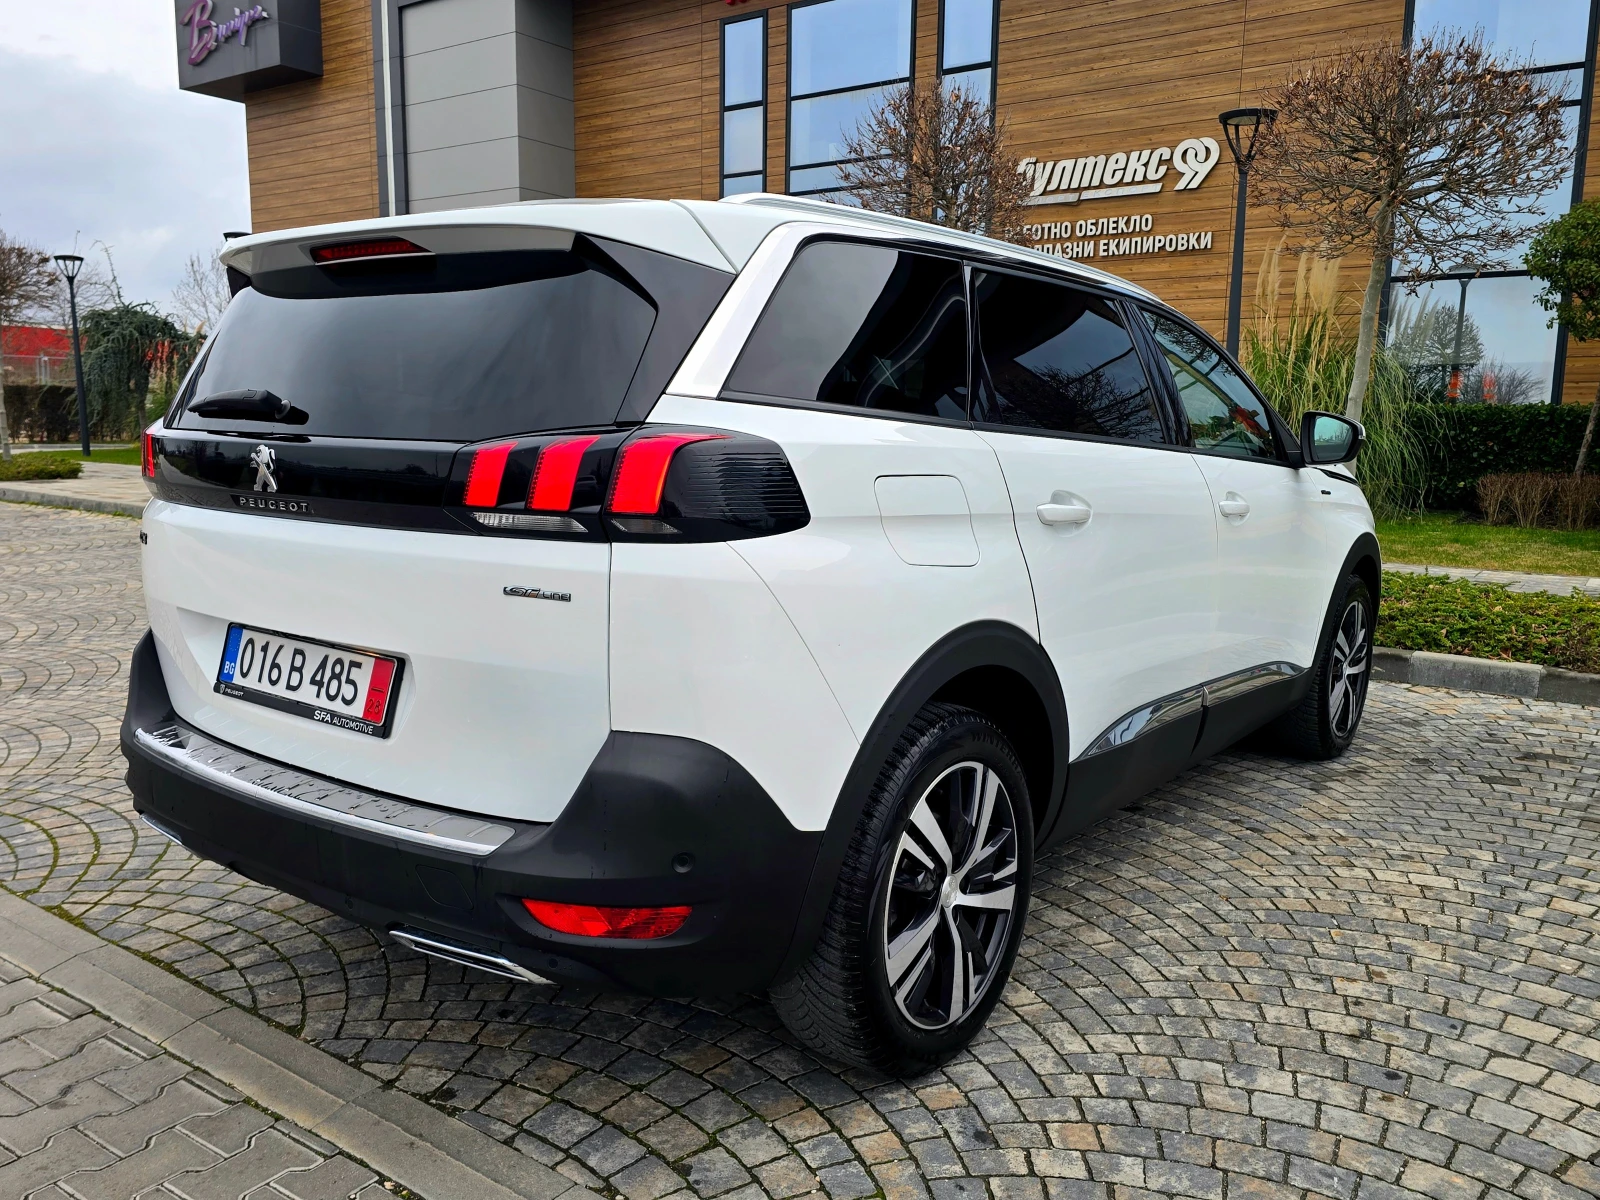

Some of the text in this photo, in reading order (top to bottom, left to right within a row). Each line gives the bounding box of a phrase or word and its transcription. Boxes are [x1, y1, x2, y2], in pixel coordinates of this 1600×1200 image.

[1075, 213, 1153, 237] ОБЛЕКЛО
[1098, 231, 1213, 257] ЕКИПИРОВКИ
[239, 497, 308, 512] PEUGEOT
[223, 661, 235, 675] BG
[224, 688, 244, 697] PEUGEOT
[313, 710, 373, 734] SFA AUTOMOTIVE
